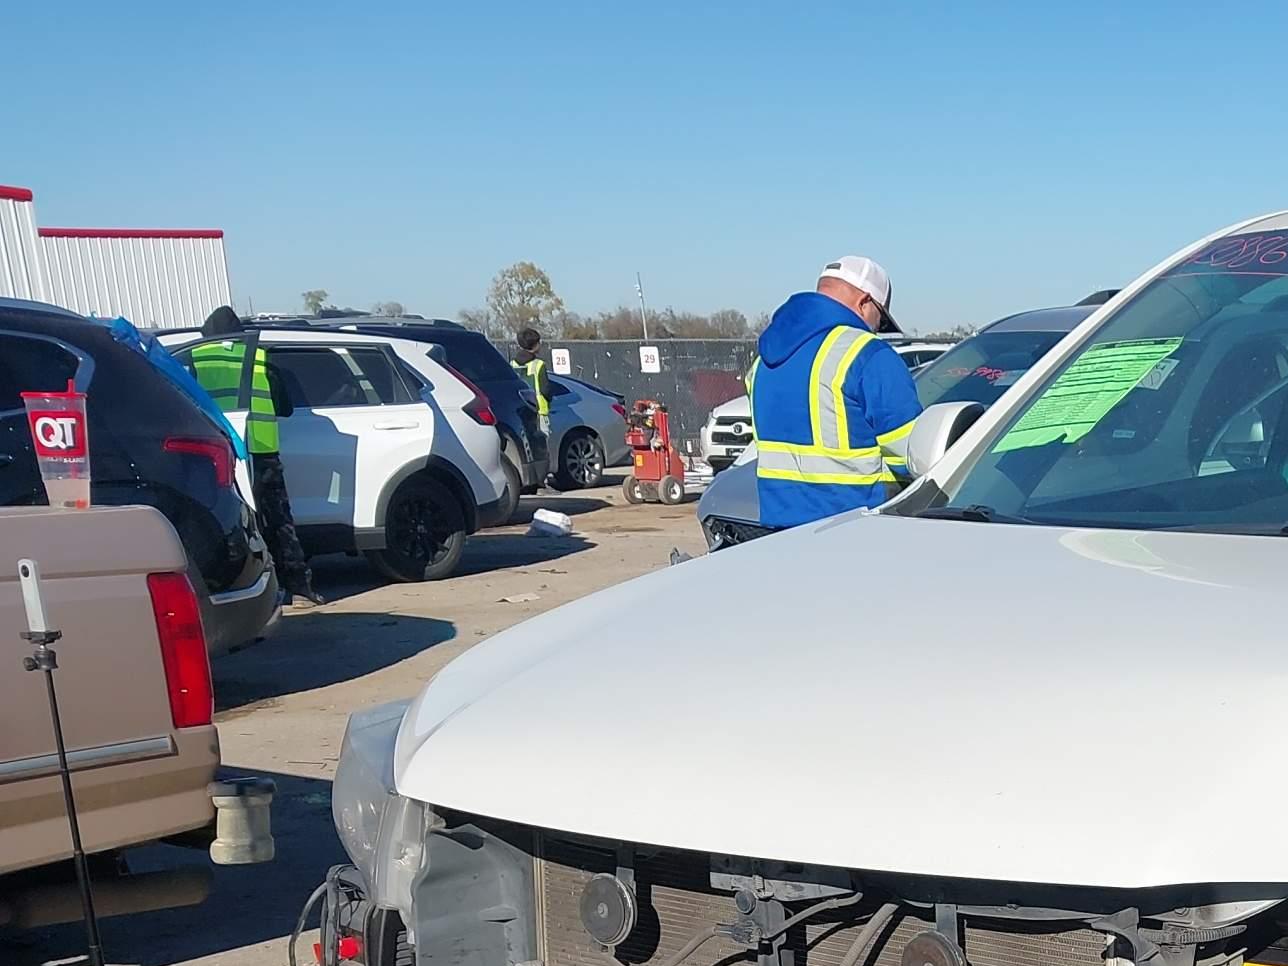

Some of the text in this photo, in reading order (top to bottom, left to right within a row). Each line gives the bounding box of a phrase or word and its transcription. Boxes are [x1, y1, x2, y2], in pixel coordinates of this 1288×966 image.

[555, 356, 567, 366] 28
[644, 354, 656, 364] 29
[35, 416, 76, 449] QT
